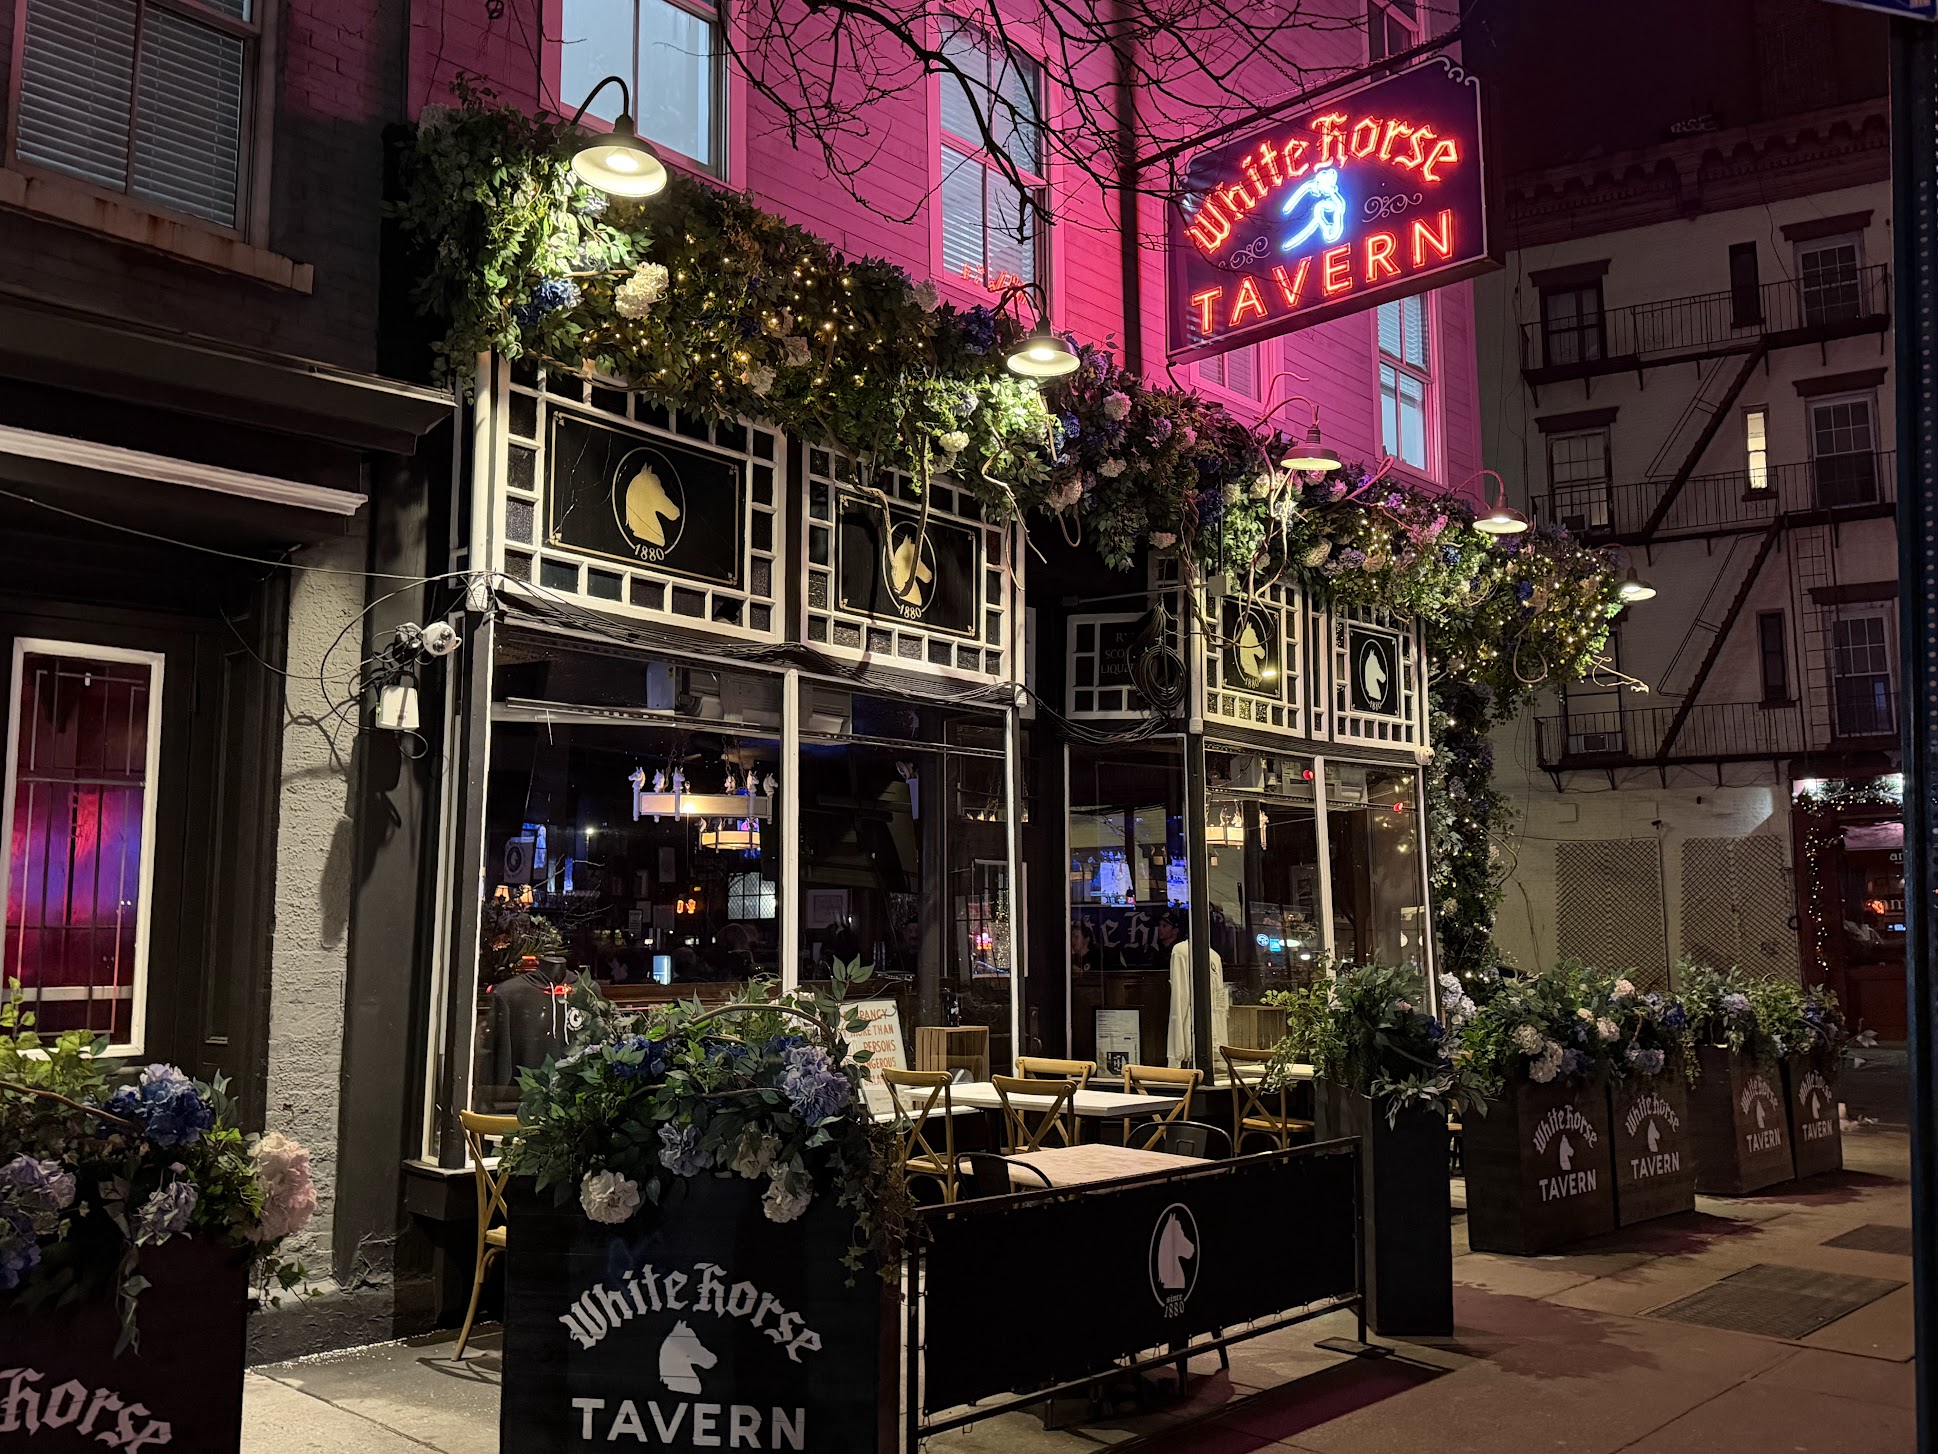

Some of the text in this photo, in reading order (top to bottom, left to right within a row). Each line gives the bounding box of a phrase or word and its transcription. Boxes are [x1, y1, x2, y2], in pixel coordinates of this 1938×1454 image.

[1183, 137, 1310, 254] White
[1191, 208, 1455, 335] TAVERN
[634, 543, 665, 562] 1880
[899, 603, 922, 619] 1880
[1245, 677, 1259, 689] 1880
[872, 1023, 894, 1035] THAN
[863, 1040, 896, 1053] PERSONS
[860, 1057, 896, 1069] NGEROUS
[1625, 1094, 1652, 1137] White
[1532, 1107, 1565, 1155] White
[1746, 1127, 1781, 1153] TAVERN
[1801, 1120, 1833, 1141] TAVERN
[1630, 1151, 1680, 1180] TAVERN
[1538, 1169, 1597, 1201] TAVERN
[558, 1264, 689, 1350] White
[1164, 1301, 1184, 1319] 1880
[571, 1398, 805, 1451] TAVERN
